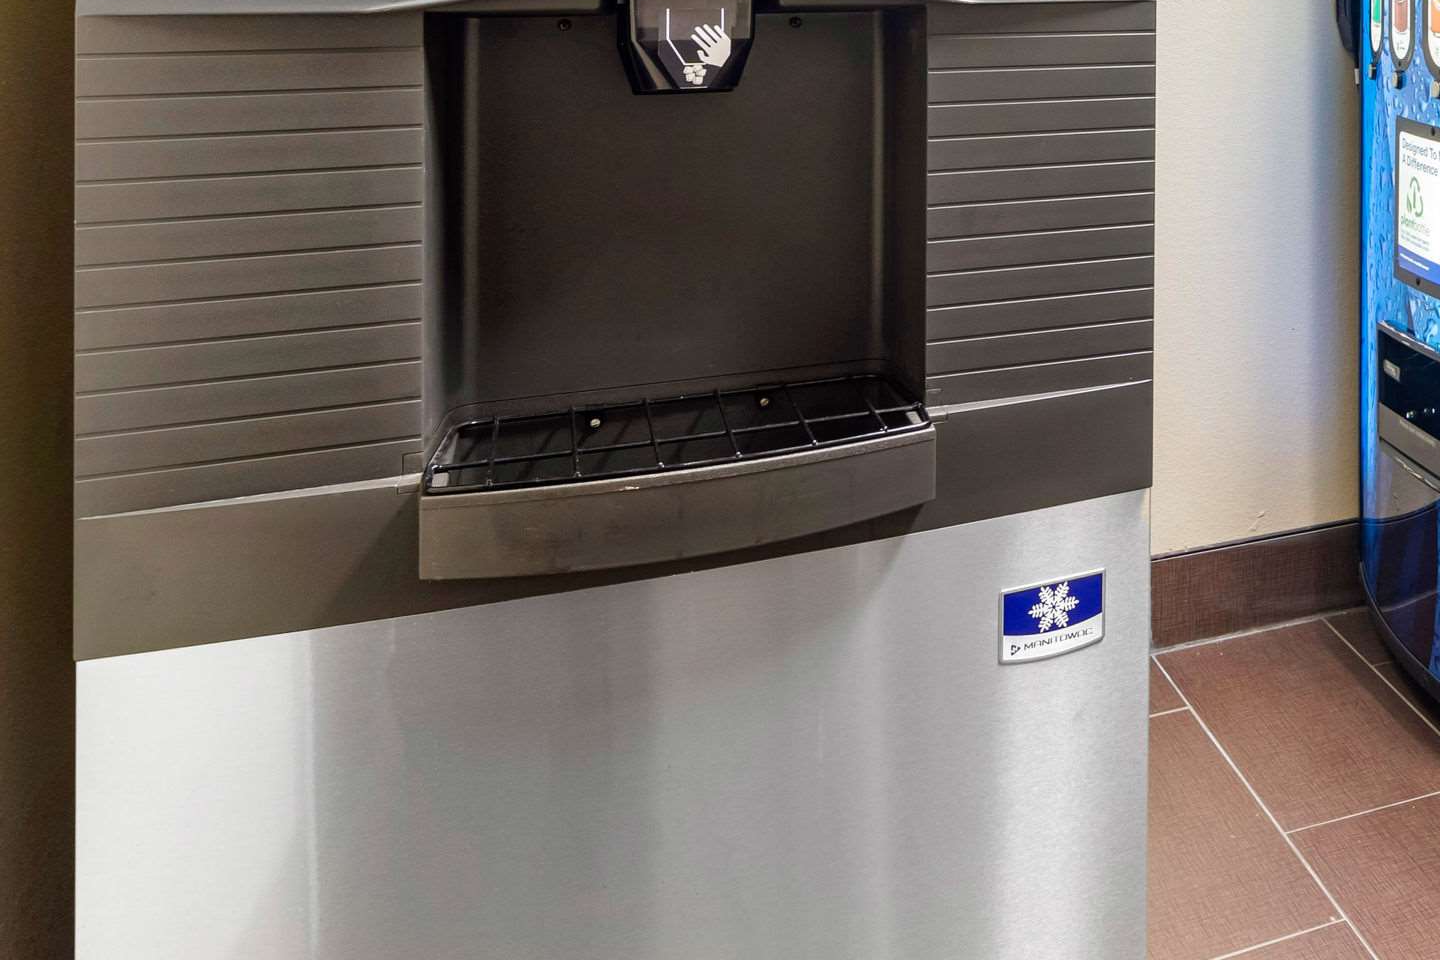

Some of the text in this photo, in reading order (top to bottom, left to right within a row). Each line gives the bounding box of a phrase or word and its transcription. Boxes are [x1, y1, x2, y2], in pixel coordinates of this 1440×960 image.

[1402, 137, 1428, 157] Designed
[1429, 147, 1438, 160] To
[1407, 155, 1438, 176] Difference
[1024, 627, 1094, 651] MANITOWOC
